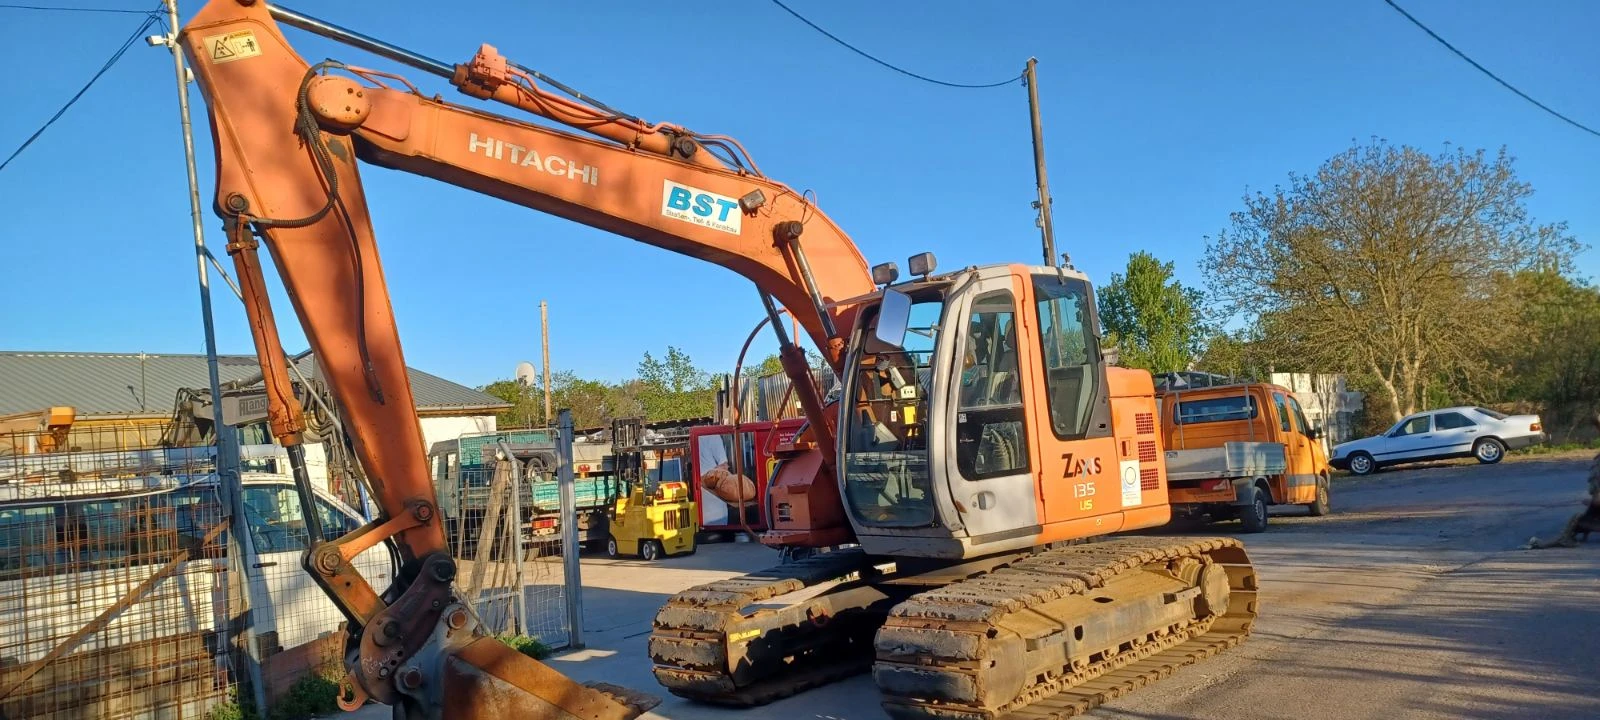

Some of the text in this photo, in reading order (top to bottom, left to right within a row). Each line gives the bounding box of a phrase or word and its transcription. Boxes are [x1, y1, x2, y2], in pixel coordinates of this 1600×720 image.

[469, 132, 598, 186] HITACHI
[667, 186, 738, 222] BST
[1074, 482, 1096, 498] 135
[1080, 499, 1093, 511] US
